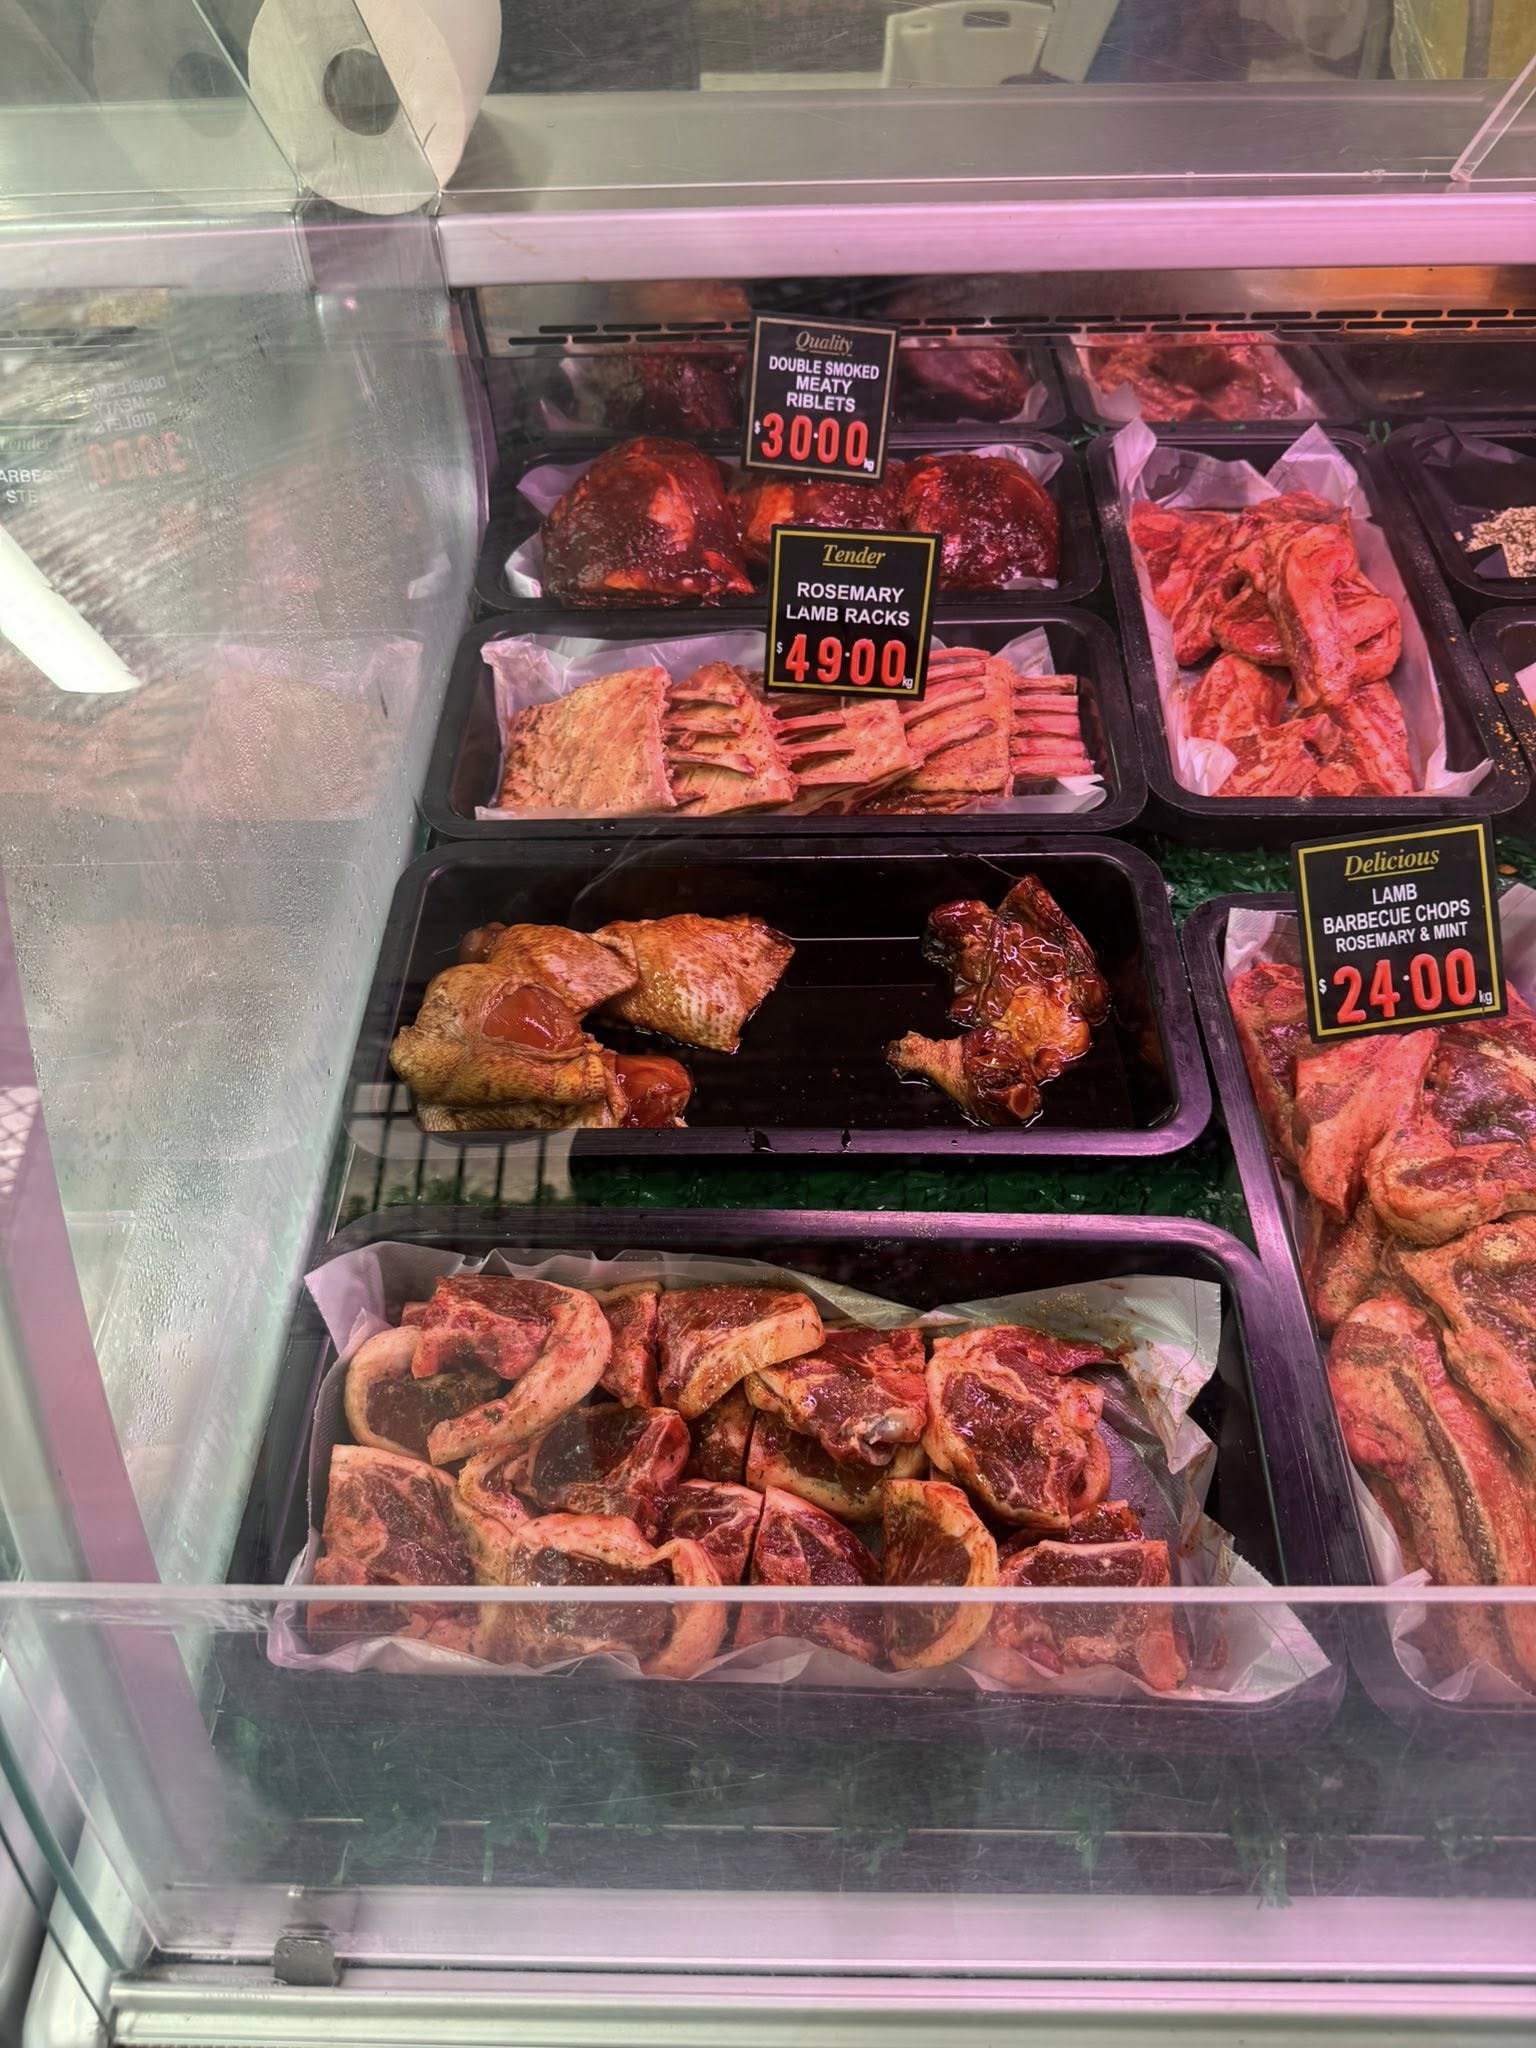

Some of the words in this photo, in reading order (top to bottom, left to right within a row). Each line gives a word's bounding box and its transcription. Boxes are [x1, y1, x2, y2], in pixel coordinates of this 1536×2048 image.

[796, 331, 853, 354] Quality
[769, 356, 821, 374] DOUBLE
[825, 361, 879, 379] SMOKED
[796, 375, 853, 394] MEATY
[786, 392, 855, 413] RIBLETS
[822, 544, 886, 565] Tender
[797, 582, 904, 603] ROSEMARY
[786, 604, 838, 622] LAMB
[845, 608, 910, 627] RACKS
[1344, 849, 1440, 877] Delicious
[1372, 883, 1418, 905] LAMB
[1323, 907, 1411, 935] BARBECUE
[1415, 899, 1471, 921] CHOPS
[1336, 928, 1416, 953] ROSEMARY
[1420, 926, 1430, 942] &
[1434, 921, 1468, 940] MINT
